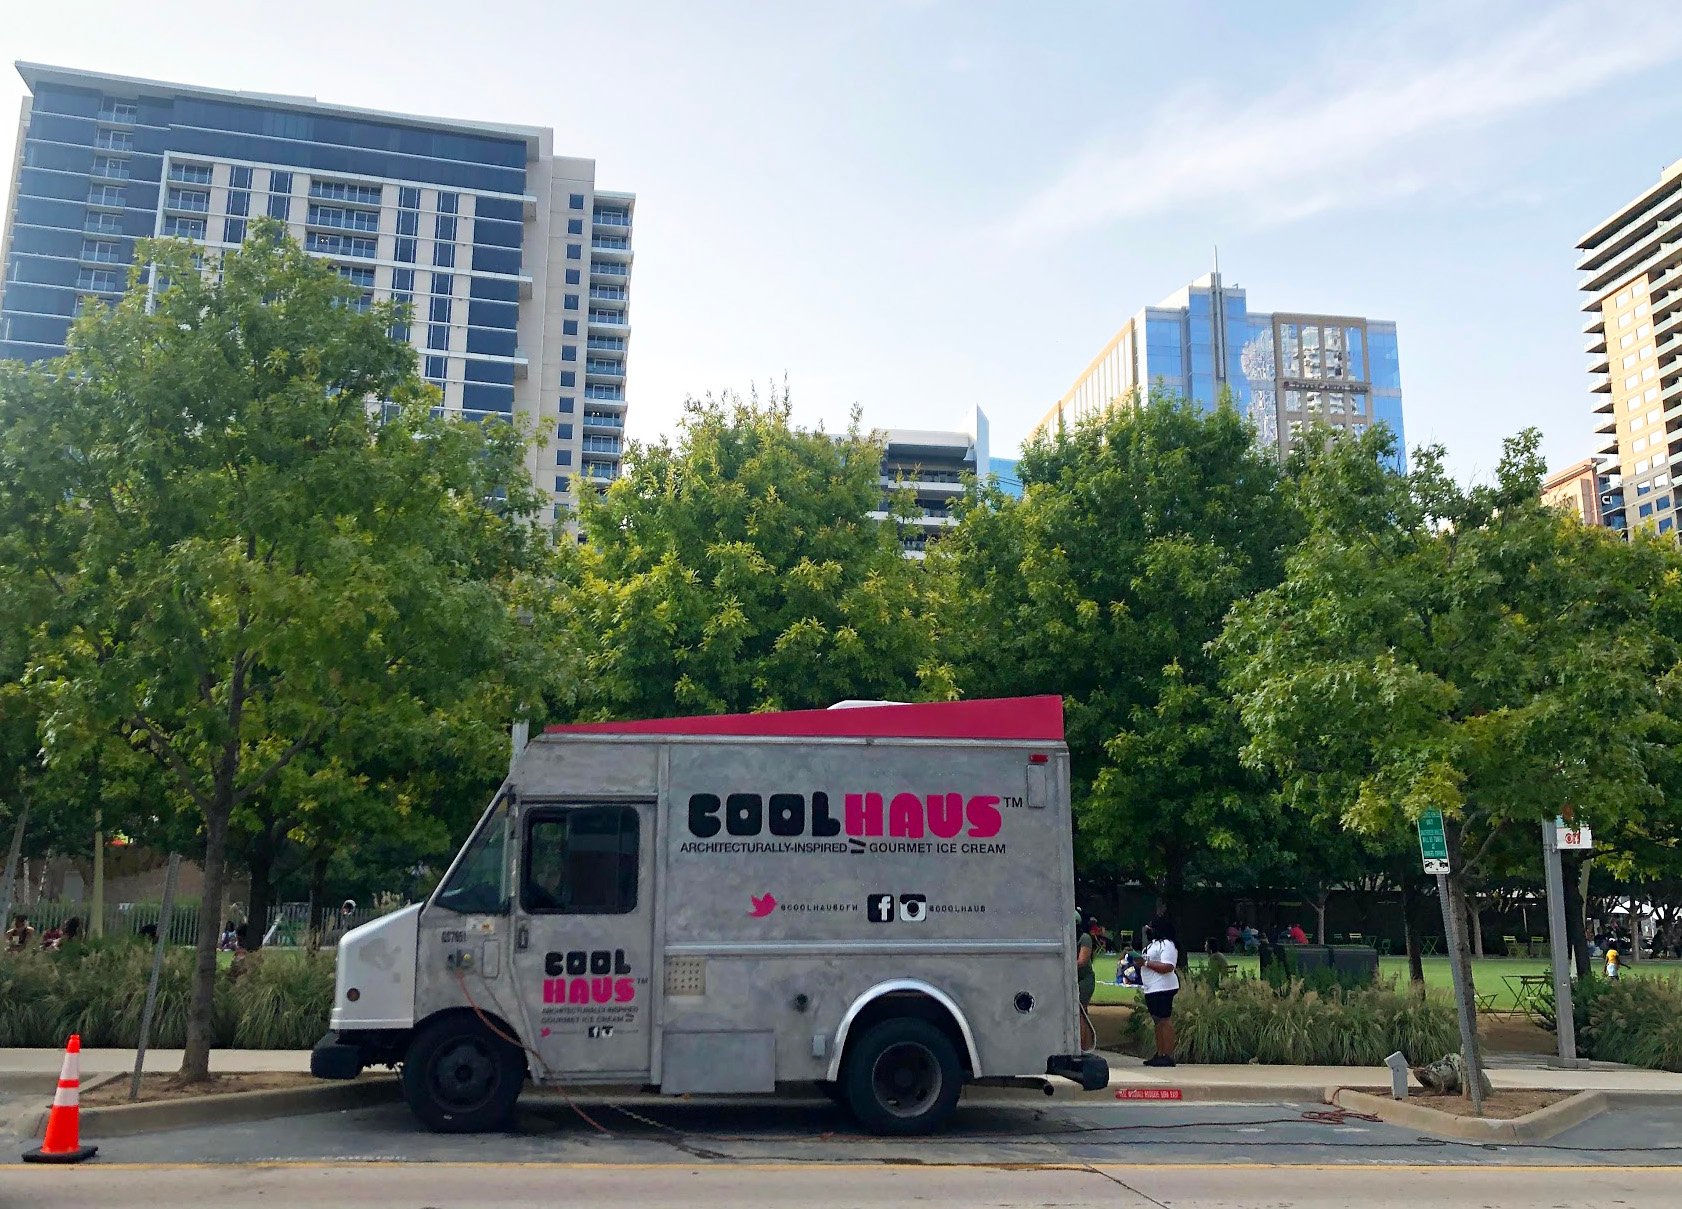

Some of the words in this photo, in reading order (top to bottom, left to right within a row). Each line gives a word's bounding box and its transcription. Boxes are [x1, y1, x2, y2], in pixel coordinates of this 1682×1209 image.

[869, 842, 933, 854] GOURMET
[936, 843, 957, 854] ICE
[961, 843, 1006, 854] CREAM
[545, 948, 631, 976] COOL
[543, 976, 635, 1005] HAUS
